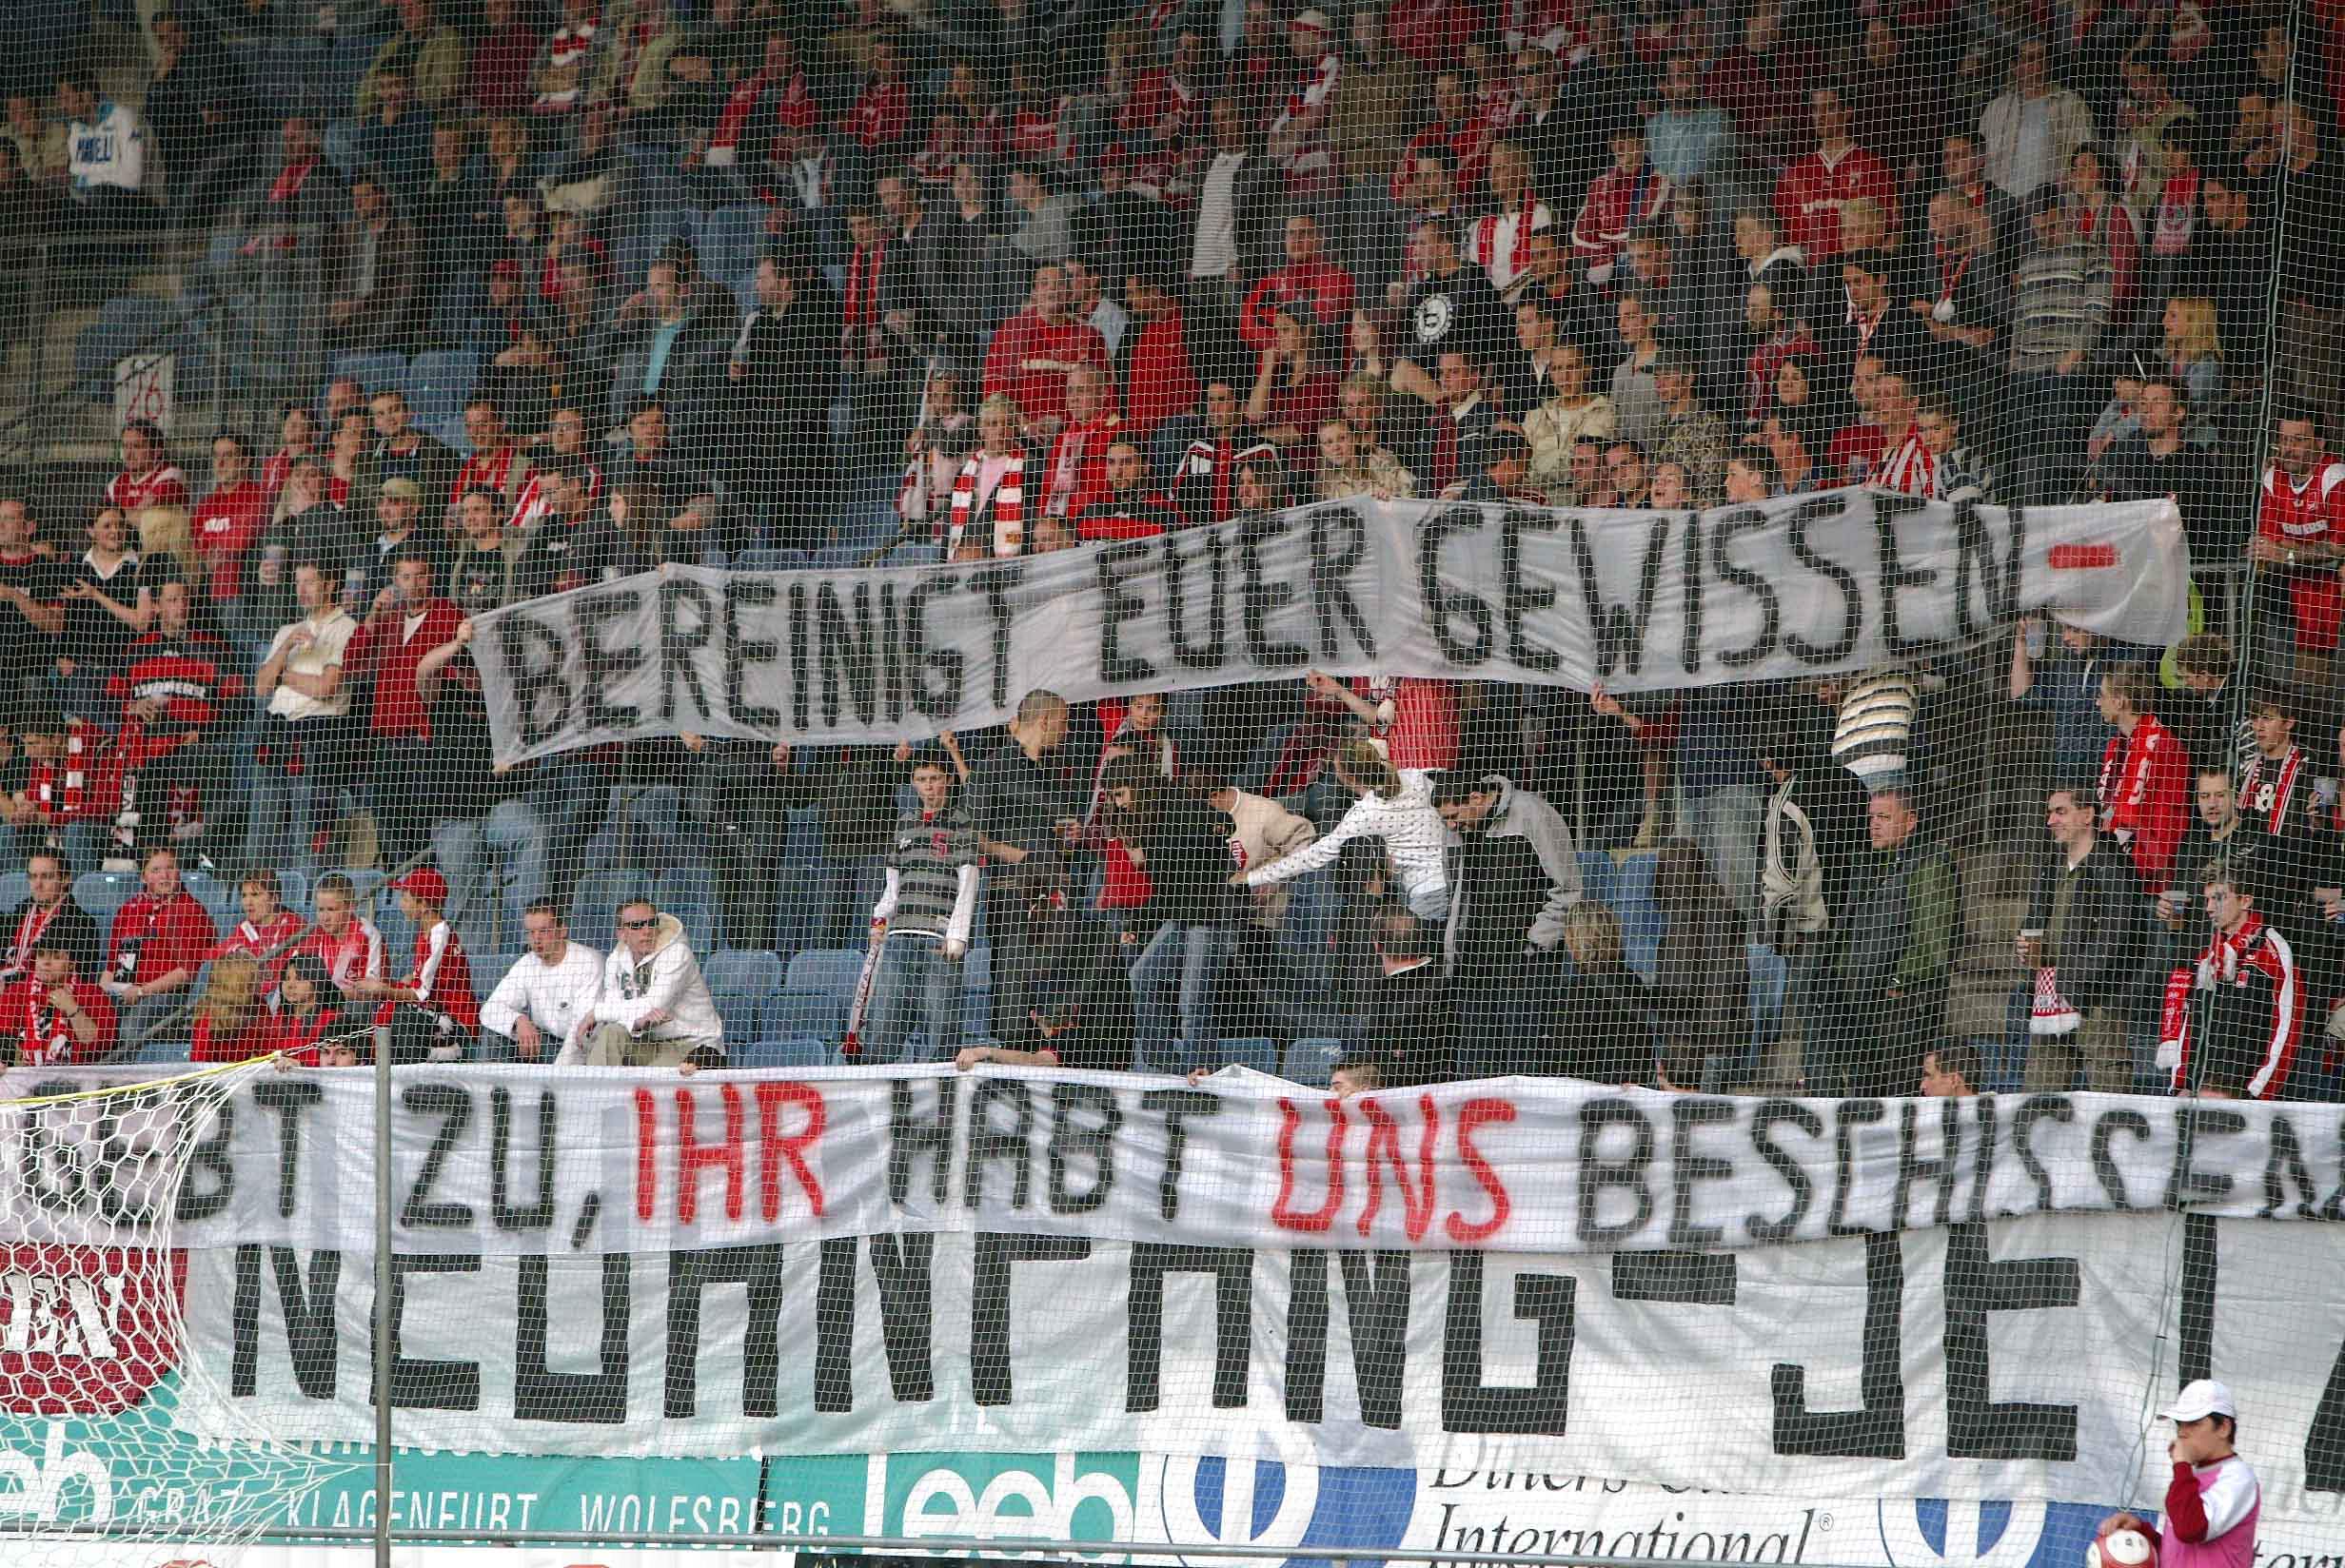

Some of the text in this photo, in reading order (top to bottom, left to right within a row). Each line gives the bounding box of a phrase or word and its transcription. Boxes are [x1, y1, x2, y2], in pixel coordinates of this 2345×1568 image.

[492, 569, 1024, 747] BEREINIGT
[1095, 506, 1378, 683] EUER
[1417, 495, 2024, 676] GEWISSEN
[400, 1083, 601, 1249] ZU,
[633, 1080, 827, 1226] IHR
[889, 1077, 1221, 1223] HABT
[1271, 1092, 1517, 1243] UNS
